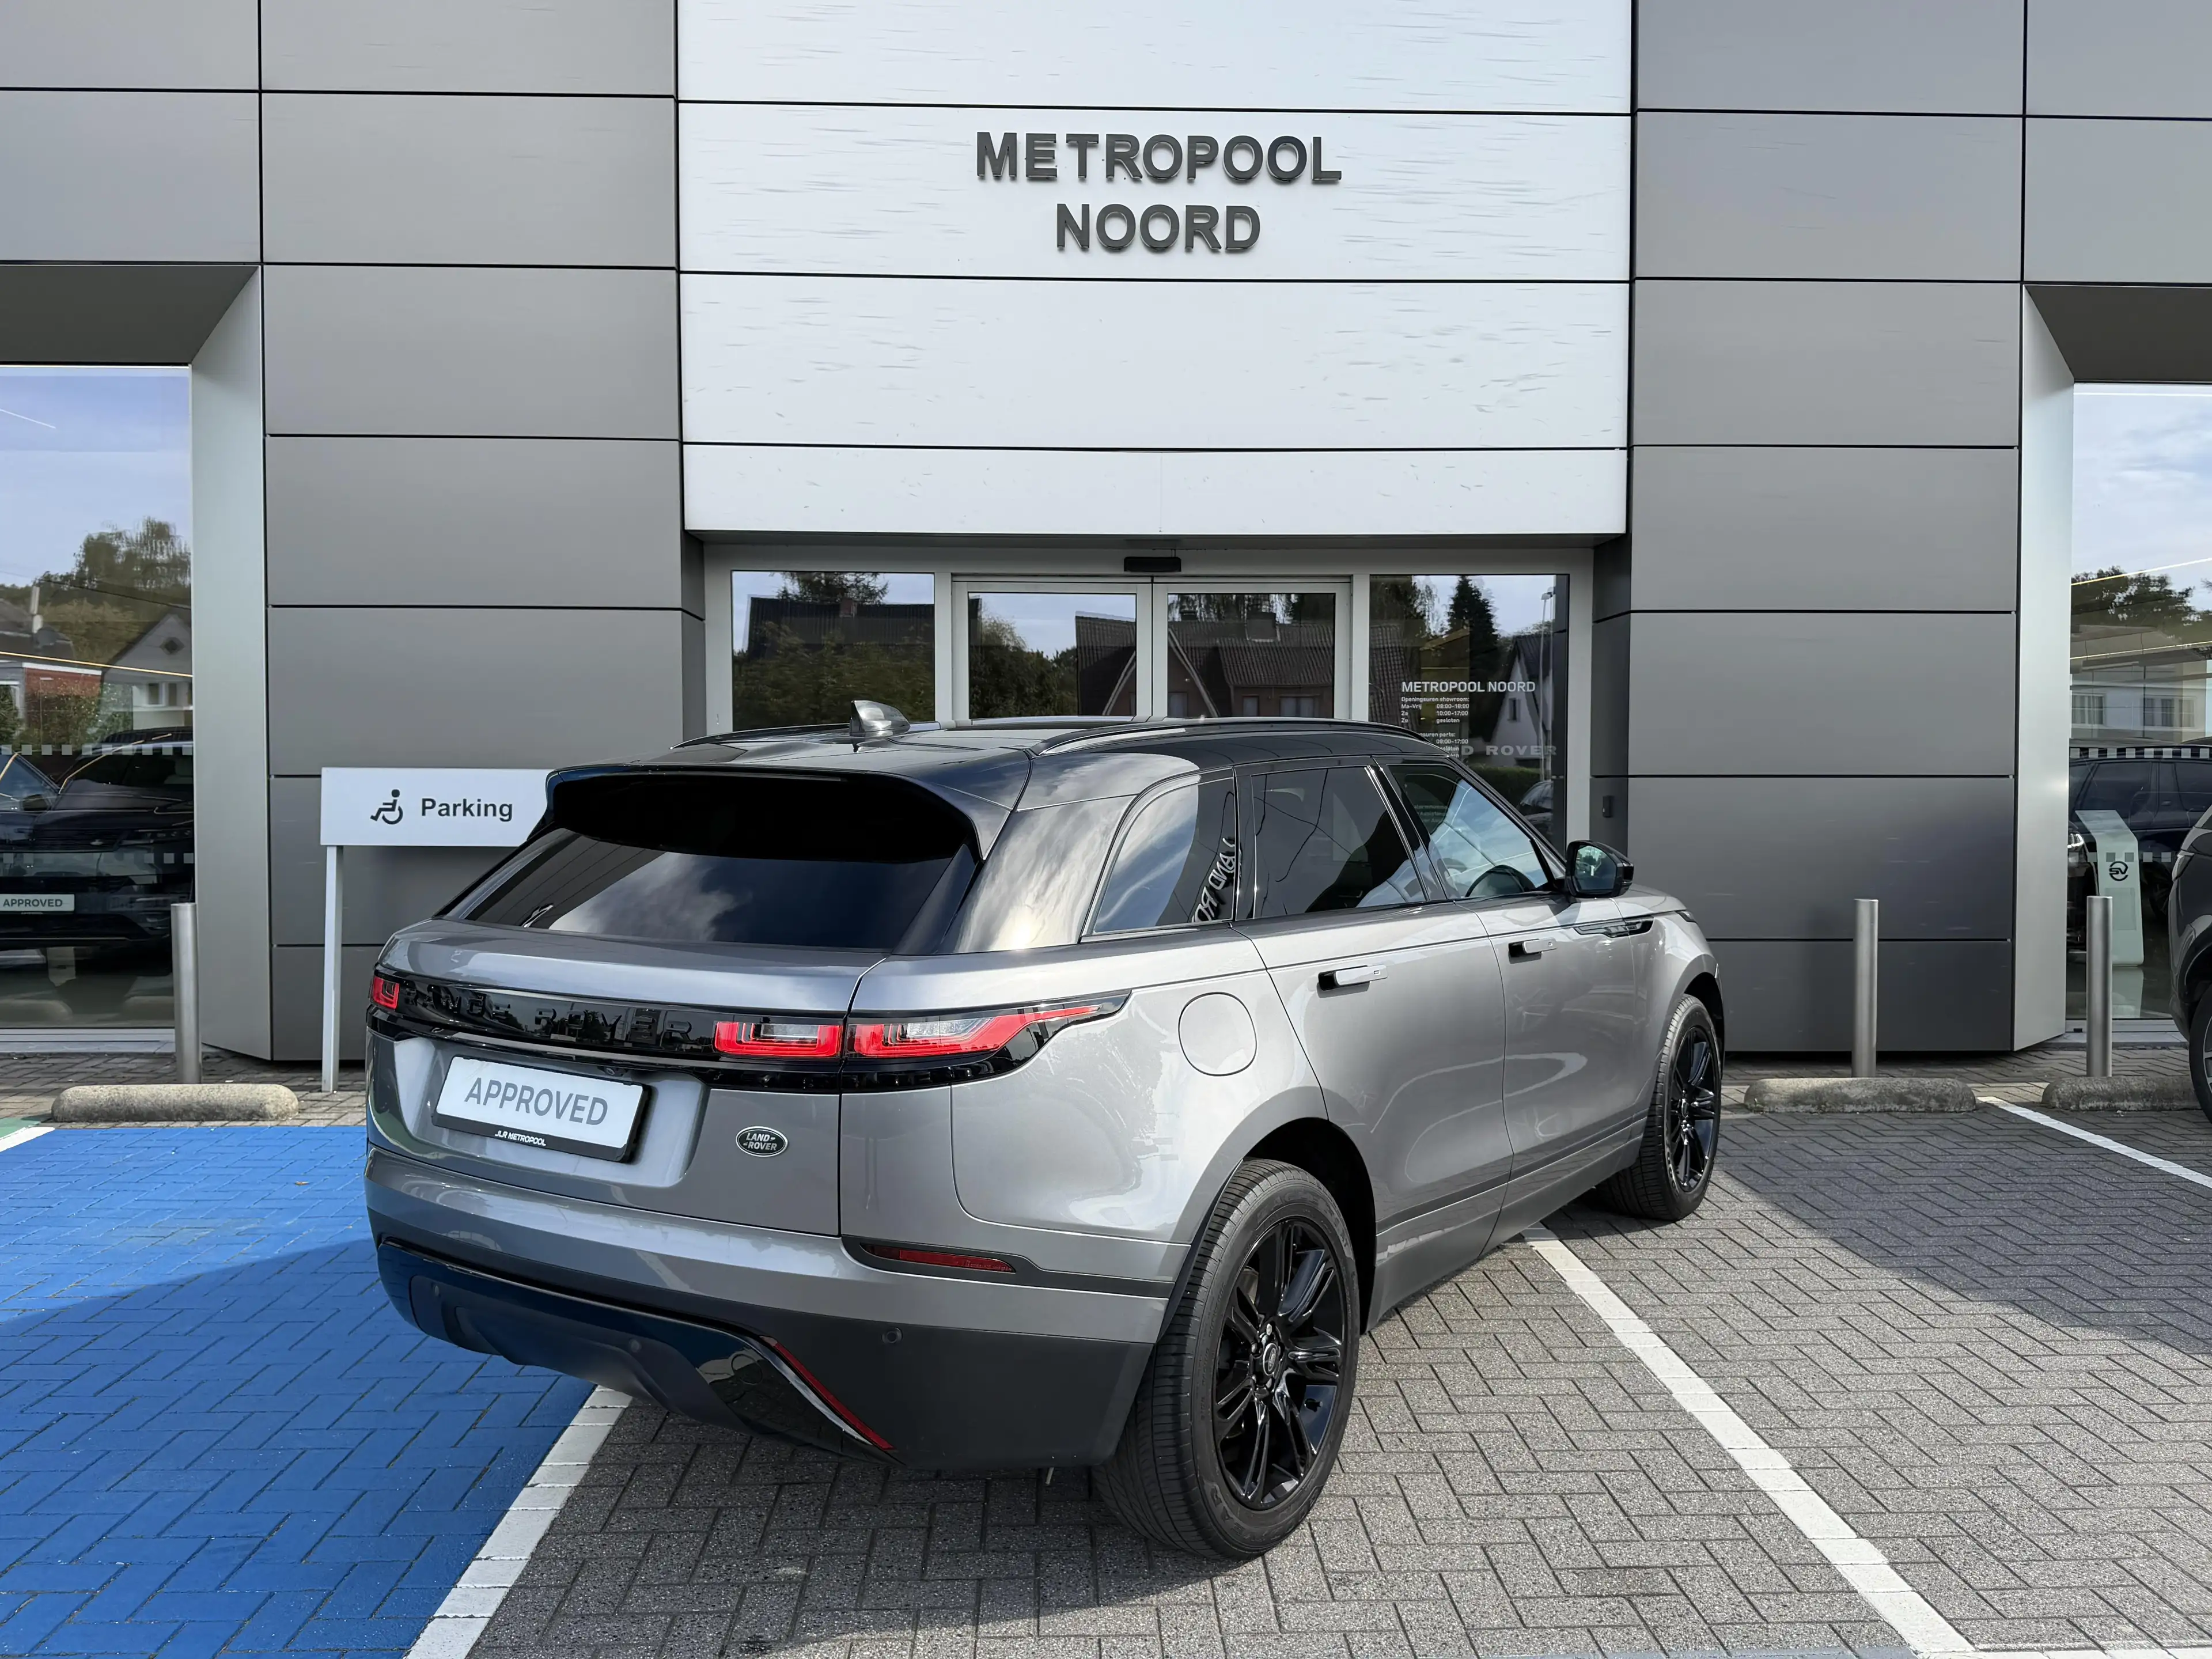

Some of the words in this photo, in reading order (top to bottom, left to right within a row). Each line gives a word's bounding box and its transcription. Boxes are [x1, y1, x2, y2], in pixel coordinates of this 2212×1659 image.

[977, 132, 1342, 181] METROPOOL
[1056, 203, 1260, 250] NOORD
[1402, 681, 1485, 692] METROPOOL
[1488, 681, 1536, 692] NOORD
[1486, 745, 1557, 756] ROVER
[422, 798, 513, 822] Parking
[3, 899, 63, 907] APPROVED
[464, 1077, 608, 1126] APPROVED
[495, 1130, 507, 1138] JLR
[507, 1132, 546, 1146] METROPOOL
[746, 1132, 770, 1142] LAND
[748, 1141, 777, 1150] ROVER
